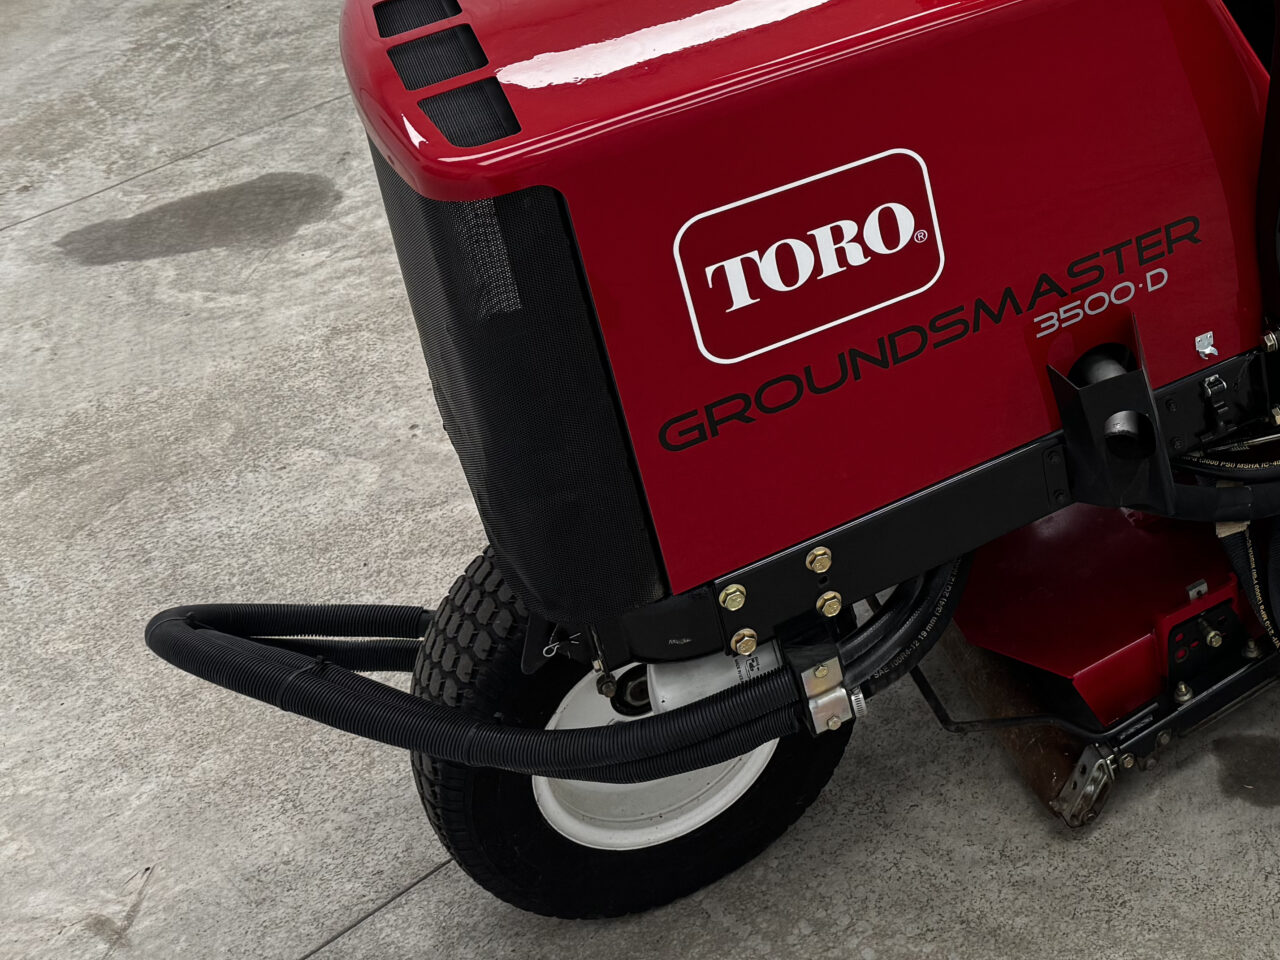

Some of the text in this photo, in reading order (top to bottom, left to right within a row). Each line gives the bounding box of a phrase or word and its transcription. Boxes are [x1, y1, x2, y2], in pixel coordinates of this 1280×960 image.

[705, 201, 917, 313] TORO
[657, 215, 1203, 453] GROUNDSMASTER
[873, 666, 890, 679] SAE
[918, 630, 928, 640] 19
[925, 616, 937, 632] mm
[935, 598, 947, 616] (3/4)
